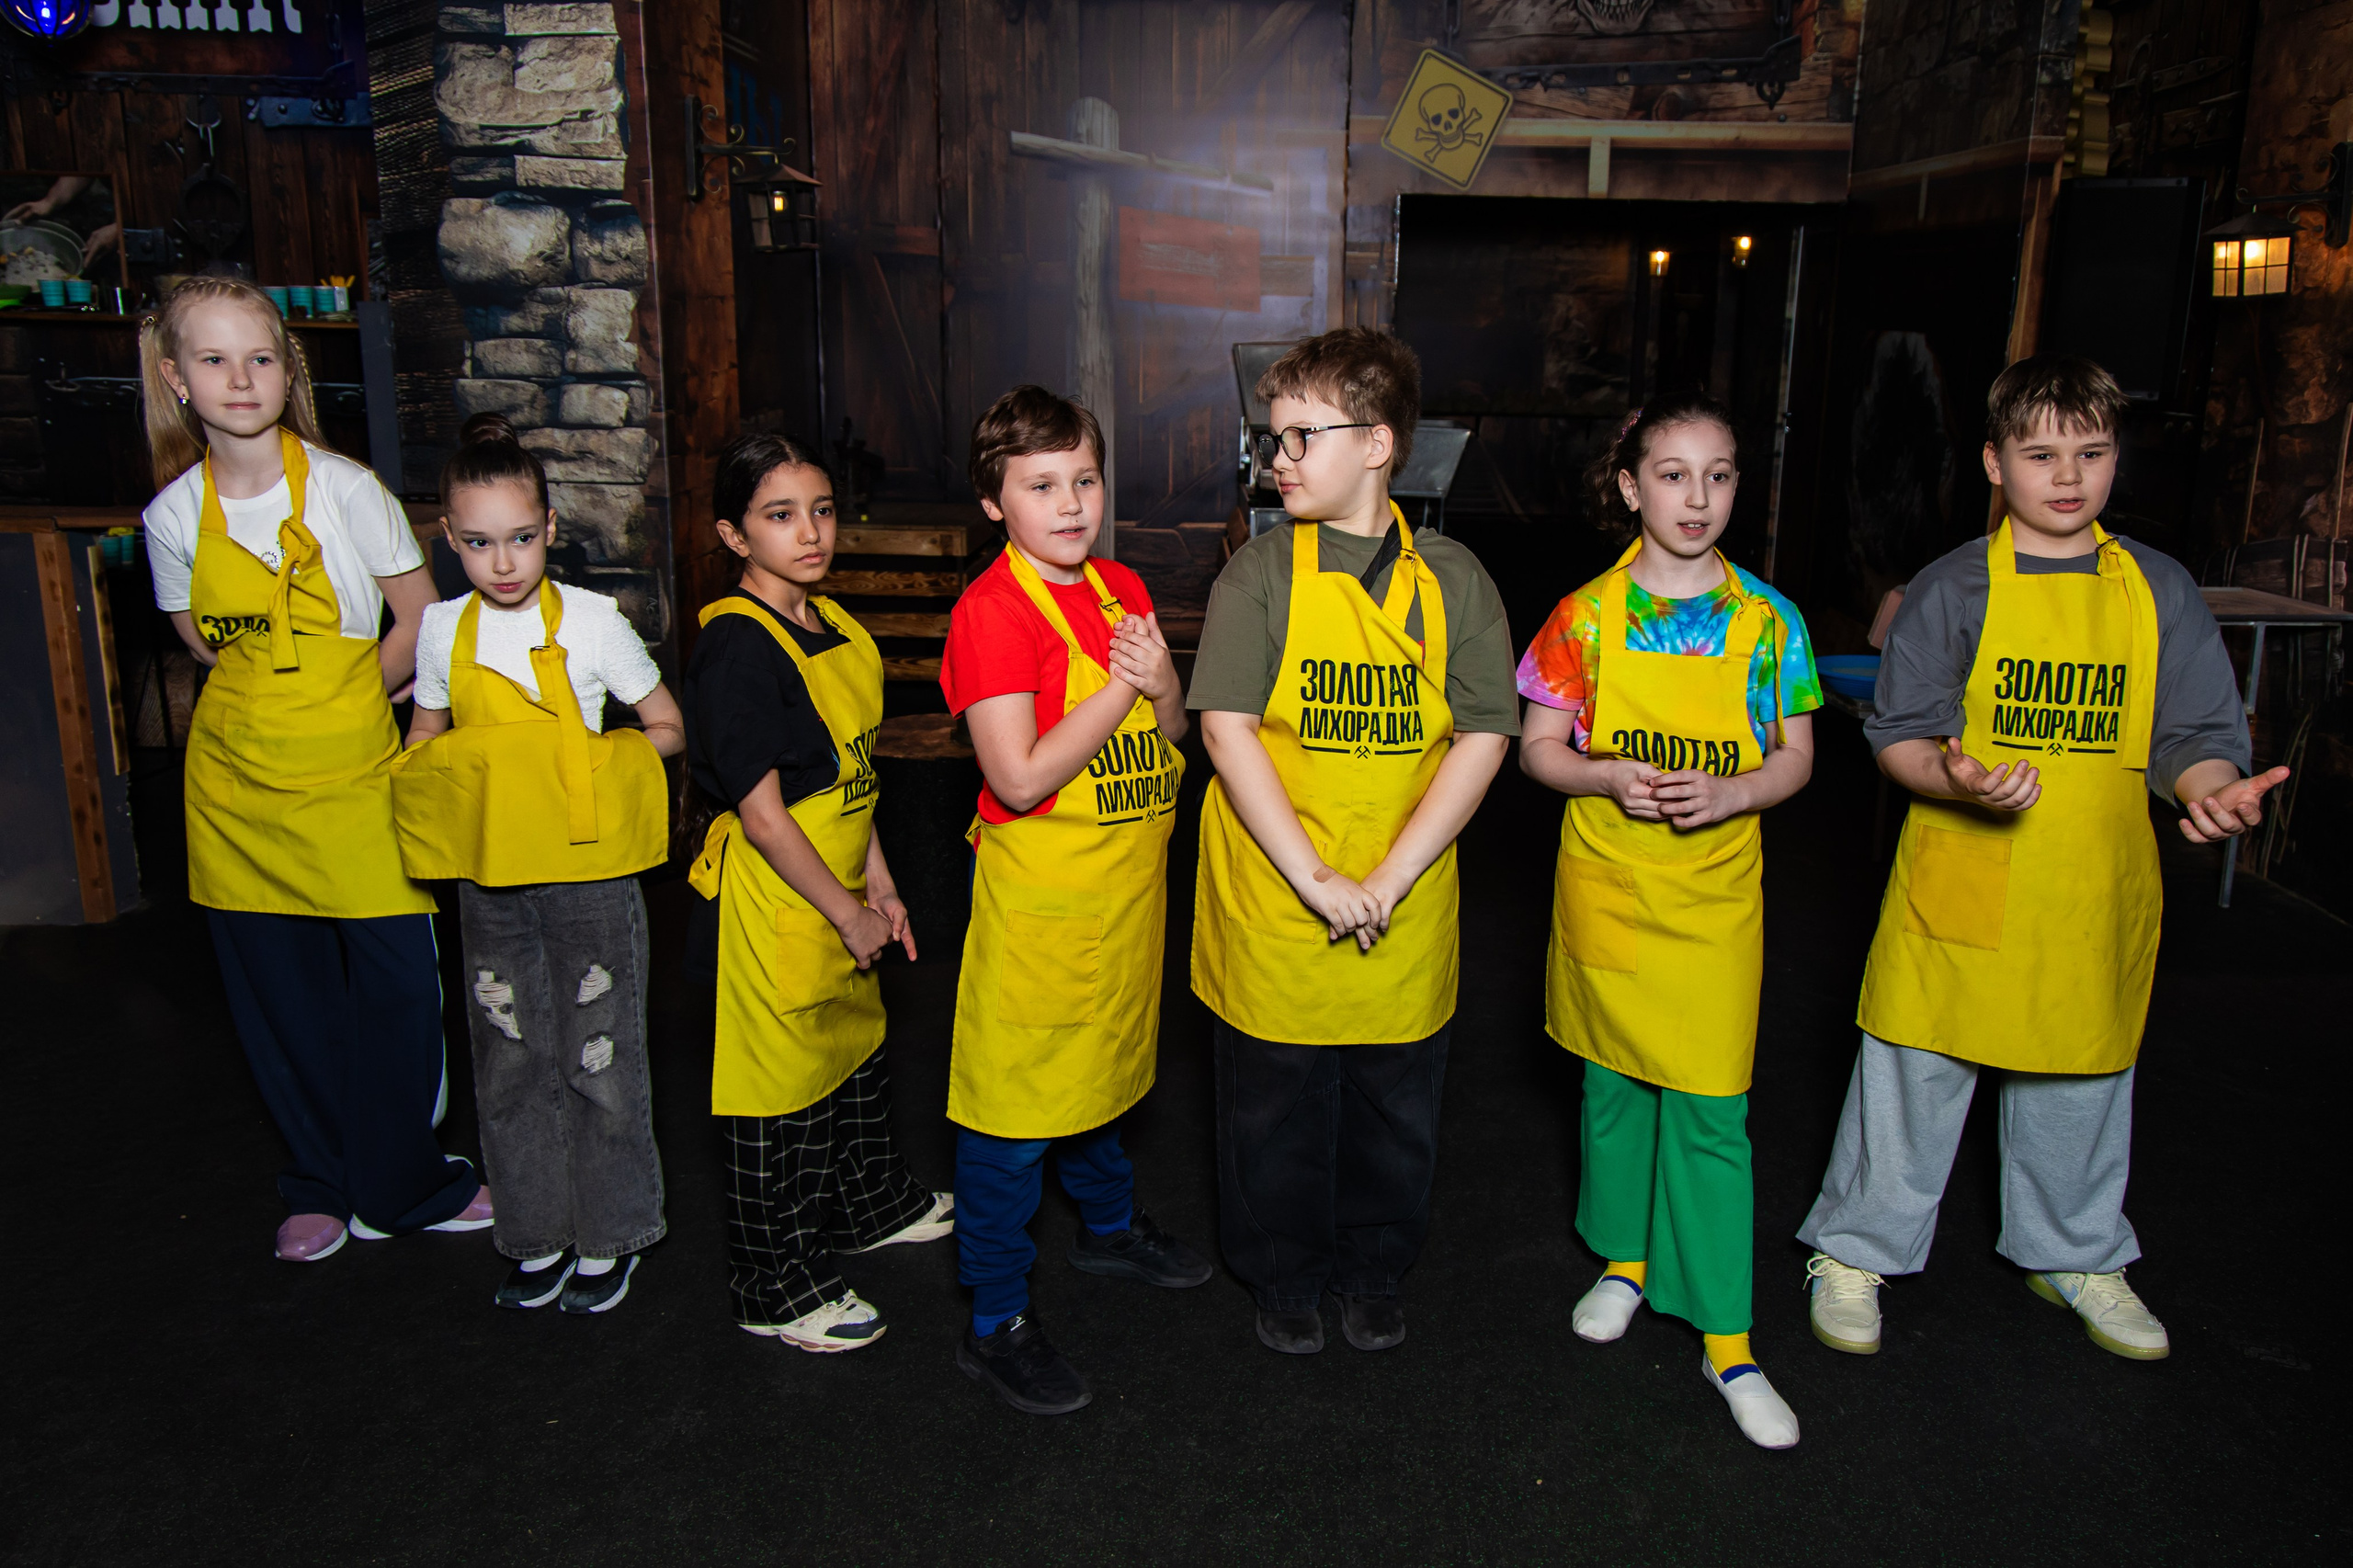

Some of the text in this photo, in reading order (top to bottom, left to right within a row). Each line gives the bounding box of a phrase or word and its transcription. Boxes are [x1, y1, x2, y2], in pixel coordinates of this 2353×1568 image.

[1300, 658, 1420, 708] ЗОЛОТАЯ
[1995, 657, 2127, 707] ЗОЛОТАЯ
[1299, 707, 1424, 745] ЛИХОРАДКА
[1992, 704, 2120, 744] ЛИХОРАДКА
[1612, 729, 1740, 777] ЗОЛОТАЯ
